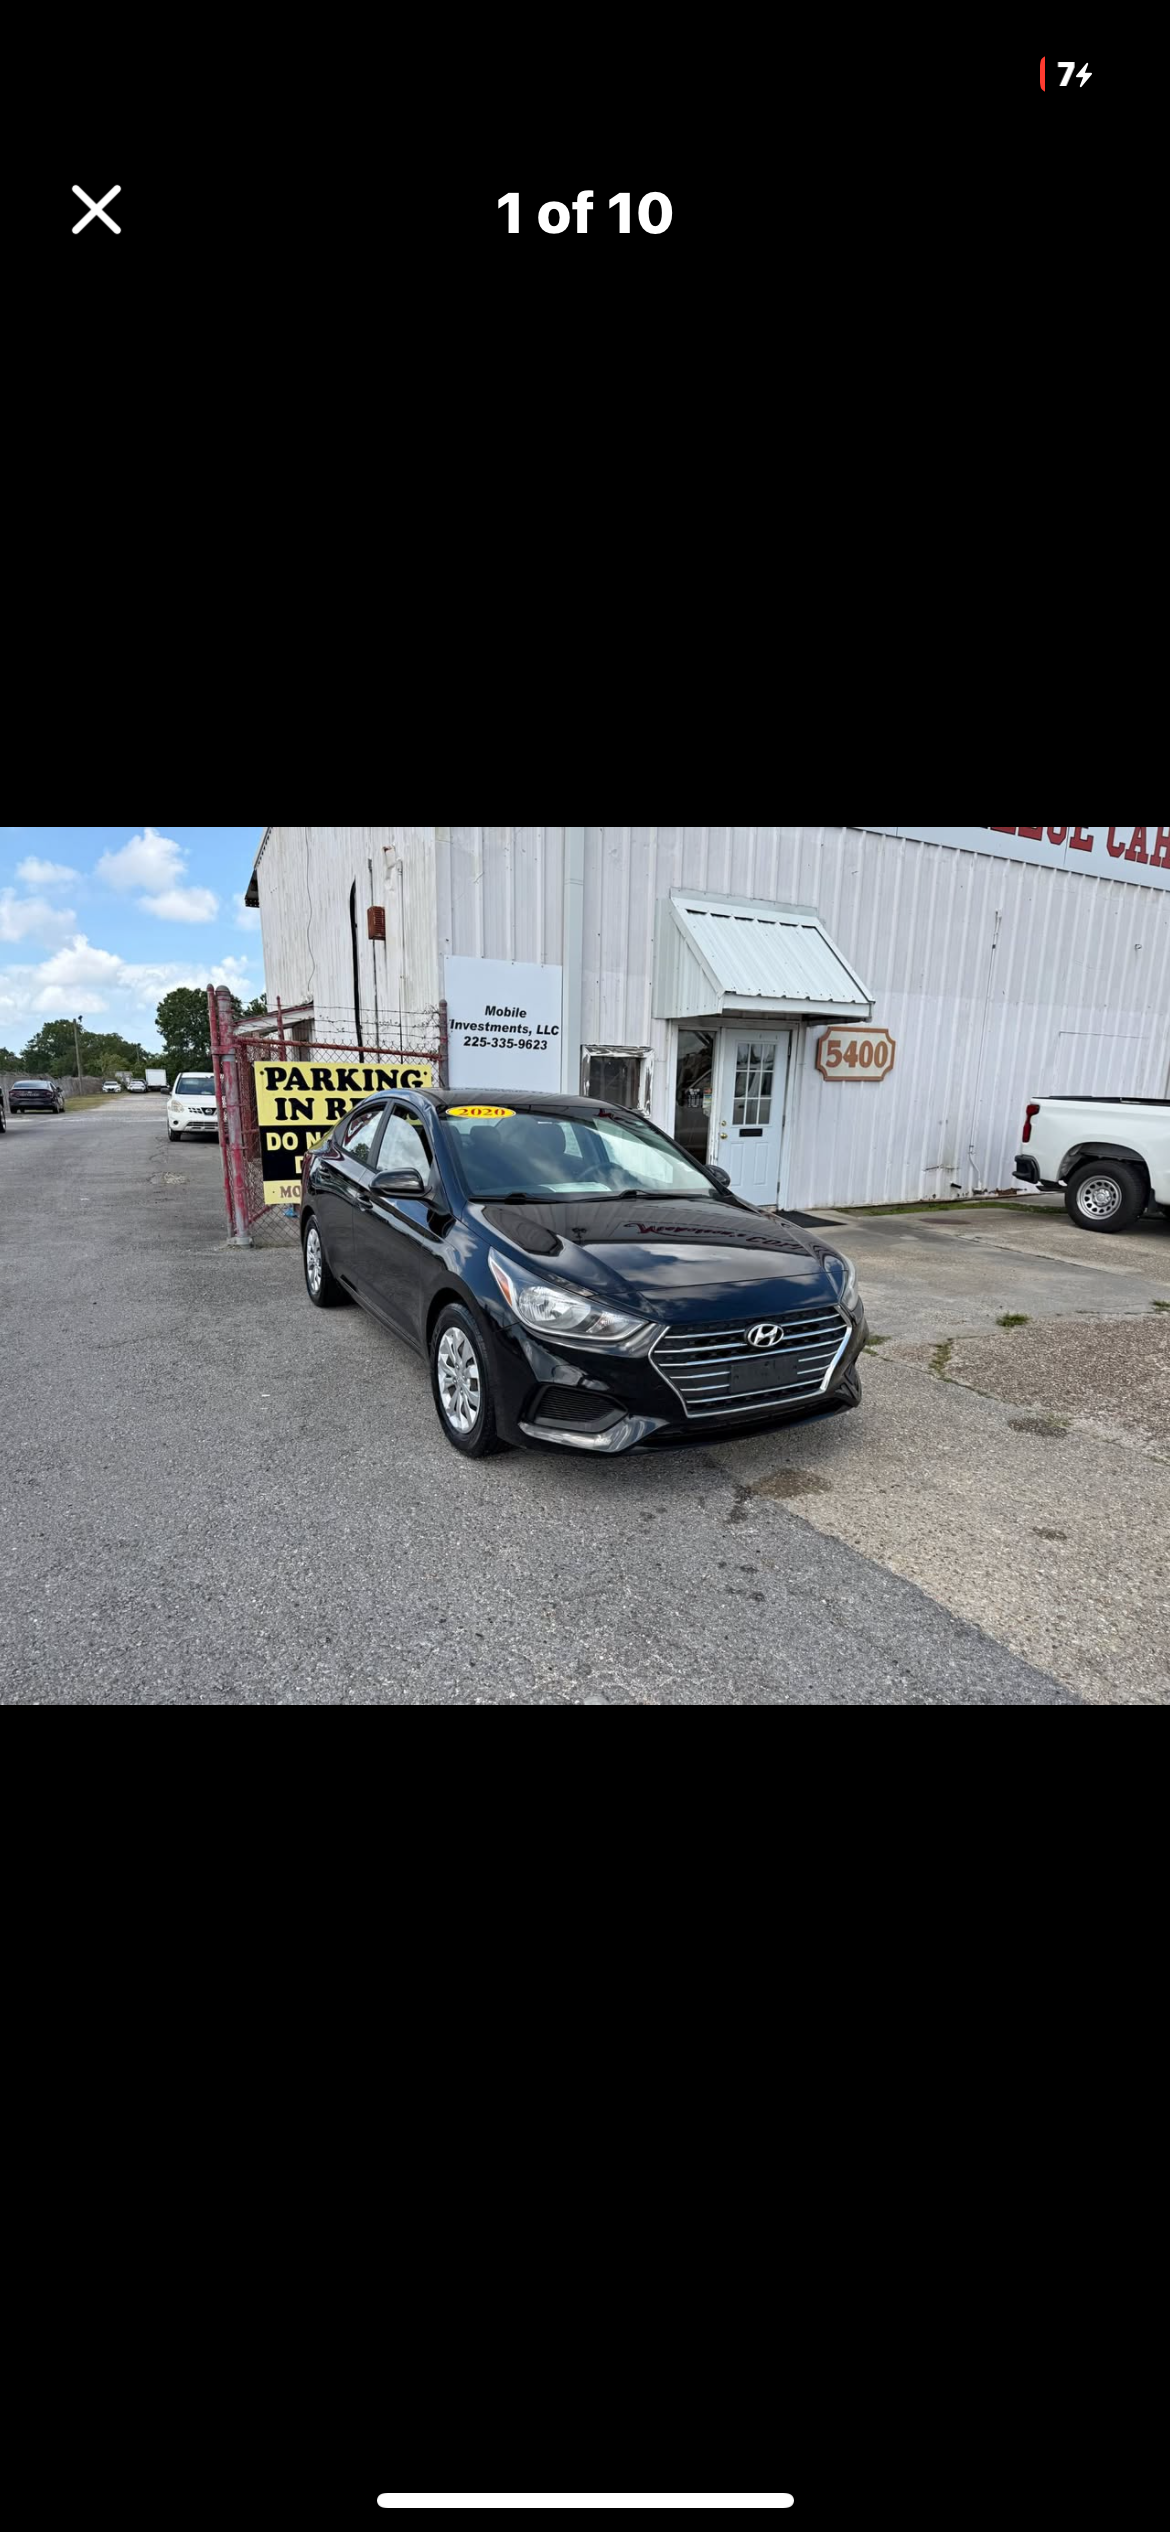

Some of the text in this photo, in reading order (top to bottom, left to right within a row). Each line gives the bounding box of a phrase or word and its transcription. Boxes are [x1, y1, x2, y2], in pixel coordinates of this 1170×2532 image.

[484, 1005, 527, 1018] Mobile
[449, 1019, 560, 1036] Investments, LLC
[463, 1036, 548, 1050] 225-335-9623
[825, 1040, 888, 1068] 5400
[264, 1067, 423, 1091] PARKING
[275, 1098, 314, 1121] IN
[458, 1108, 506, 1116] 2020
[266, 1132, 298, 1151] DO
